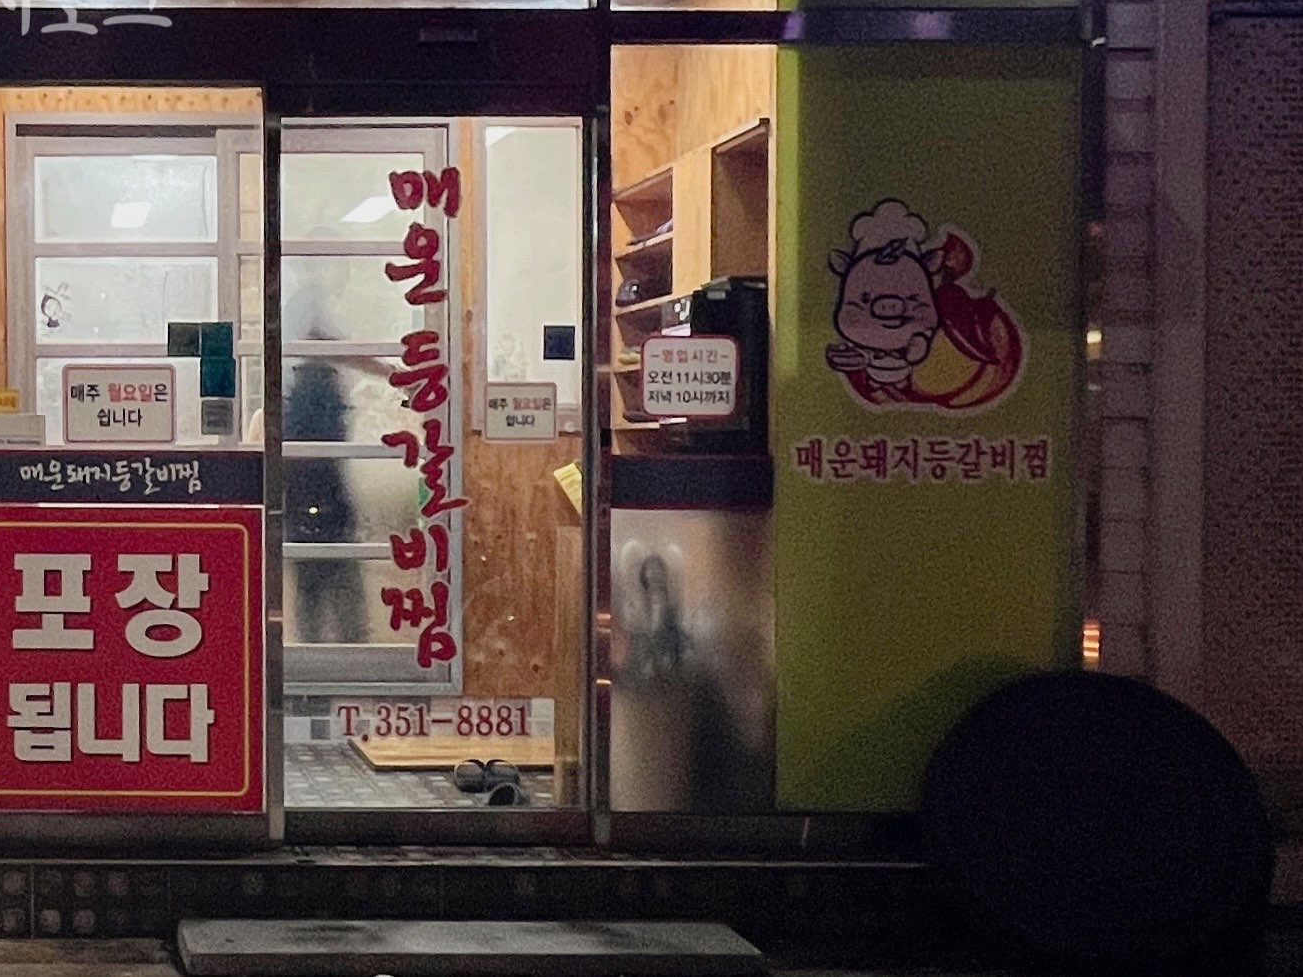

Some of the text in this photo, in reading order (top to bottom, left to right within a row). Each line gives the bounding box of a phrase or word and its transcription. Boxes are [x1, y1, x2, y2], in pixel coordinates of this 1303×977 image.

[70, 383, 168, 402] 매주 월요일은
[648, 371, 673, 384] 오전
[97, 408, 142, 427] 쉽니다
[20, 459, 202, 495] 매운돼지등갈비찜
[795, 439, 1049, 481] 매운돼지등갈비찜
[12, 553, 209, 658] 포장
[7, 682, 215, 763] 됩니다
[337, 704, 530, 742] T.351-8881
